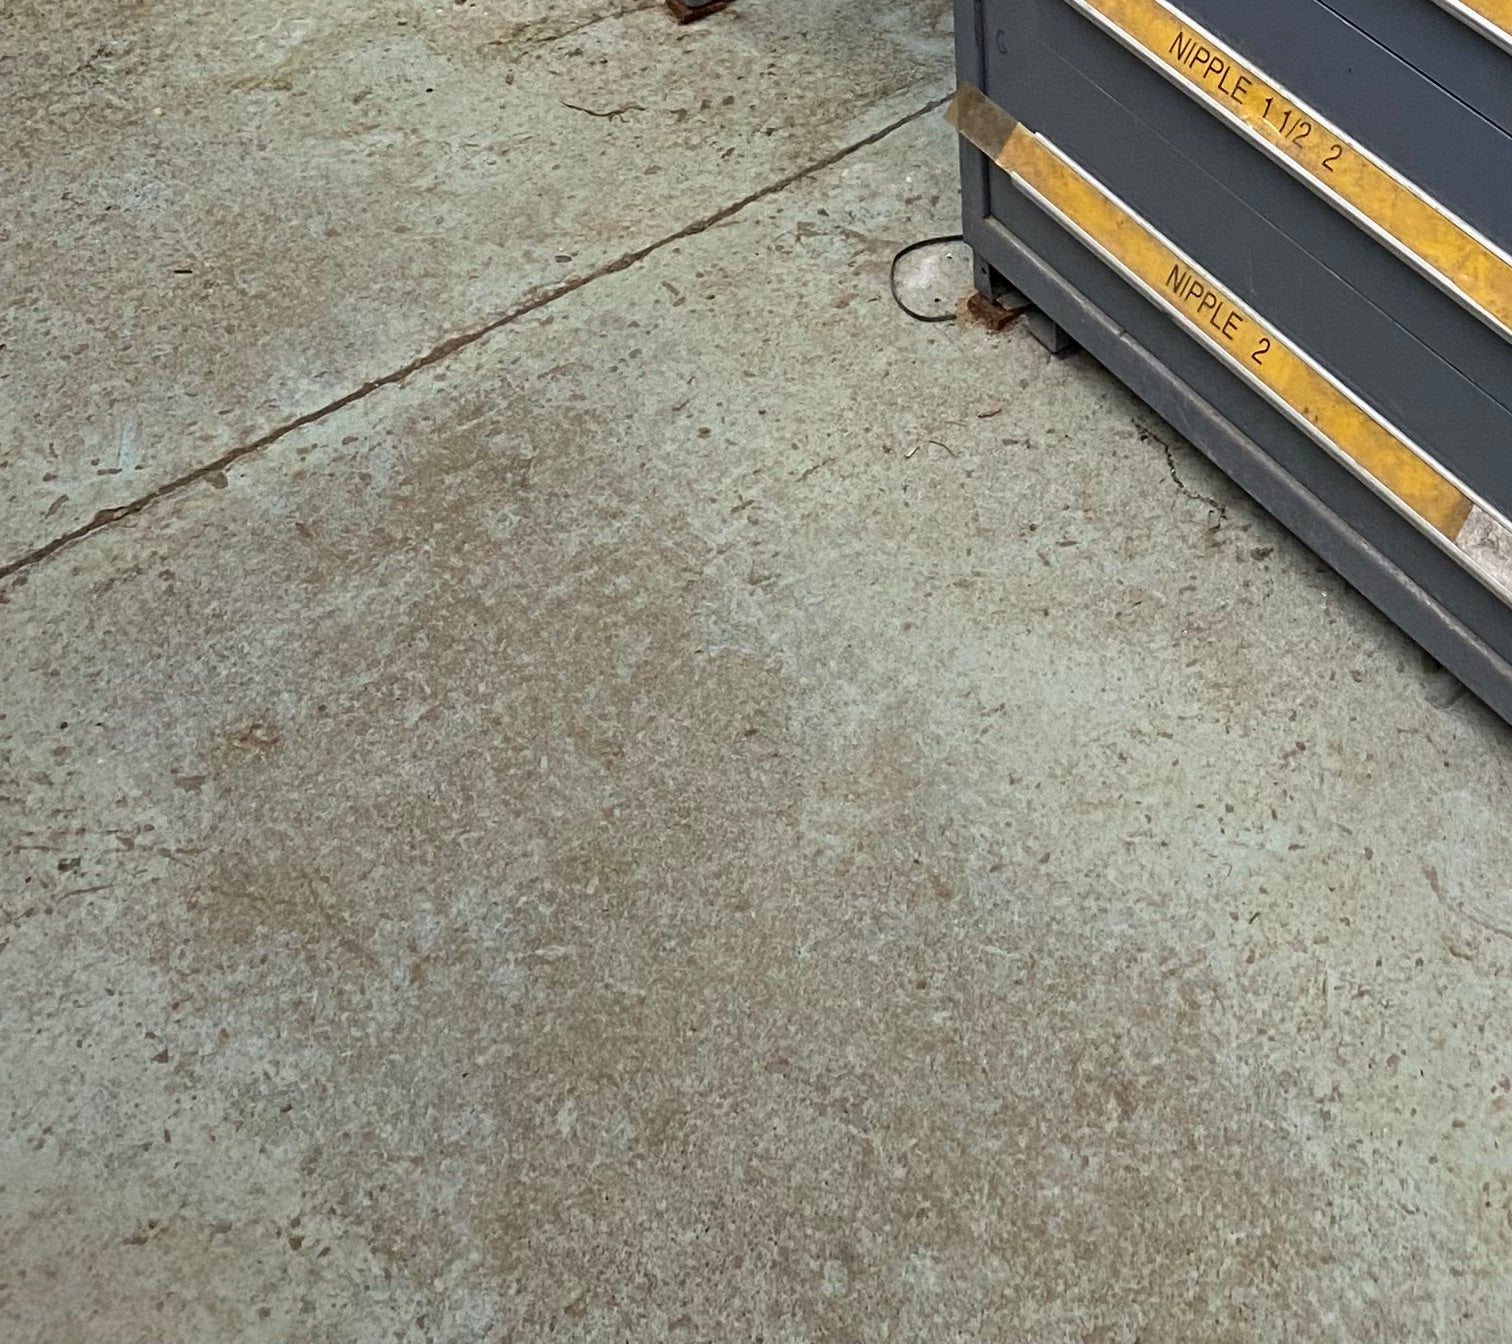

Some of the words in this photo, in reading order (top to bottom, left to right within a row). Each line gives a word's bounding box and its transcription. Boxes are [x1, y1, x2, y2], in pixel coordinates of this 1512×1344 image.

[1168, 31, 1254, 105] NIPPLE
[1260, 97, 1277, 121] 1
[1280, 108, 1313, 150] 1/2
[1322, 143, 1345, 174] 2
[1165, 264, 1239, 342] NIPPLE
[1251, 338, 1273, 366] 2
